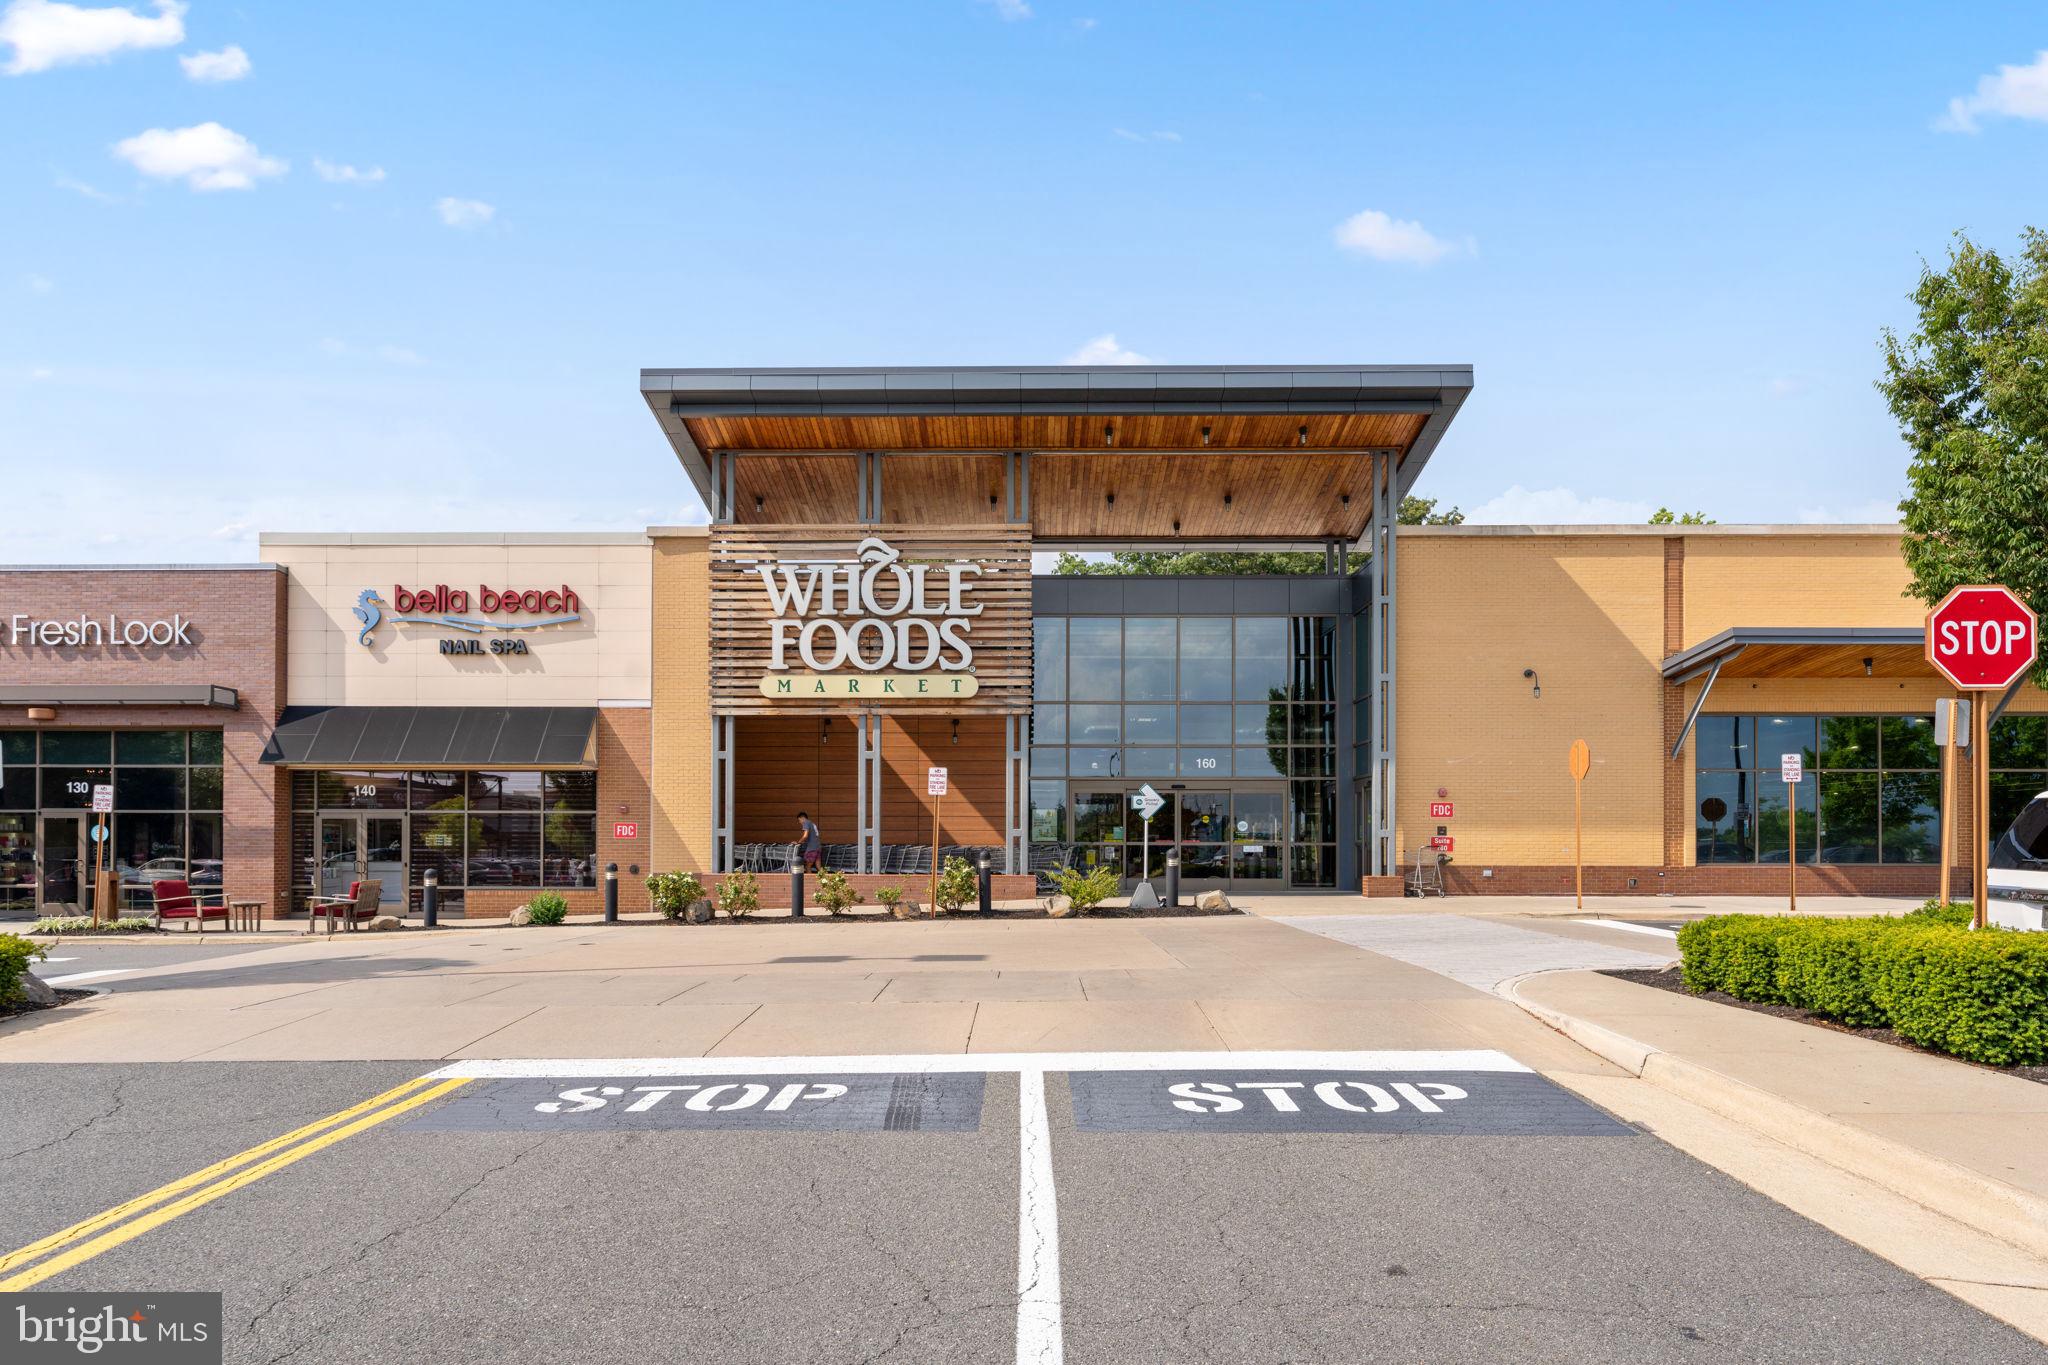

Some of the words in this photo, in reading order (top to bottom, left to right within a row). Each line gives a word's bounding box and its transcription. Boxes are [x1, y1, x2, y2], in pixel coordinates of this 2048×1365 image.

[755, 537, 984, 616] WHOLE
[394, 584, 469, 613] bella
[480, 584, 579, 613] beach
[12, 614, 102, 645] Fresh
[110, 614, 192, 645] Look
[1939, 620, 2026, 655] STOP
[439, 639, 485, 654] NAIL
[490, 639, 528, 654] SPA
[767, 617, 973, 671] FOODS
[777, 679, 962, 693] MARKET
[1196, 758, 1216, 769] 160
[66, 781, 89, 794] 130
[354, 784, 376, 796] 140
[1433, 804, 1451, 816] FDC
[616, 825, 634, 836] FDC
[534, 1083, 848, 1113] STOP
[1168, 1082, 1468, 1113] STOP
